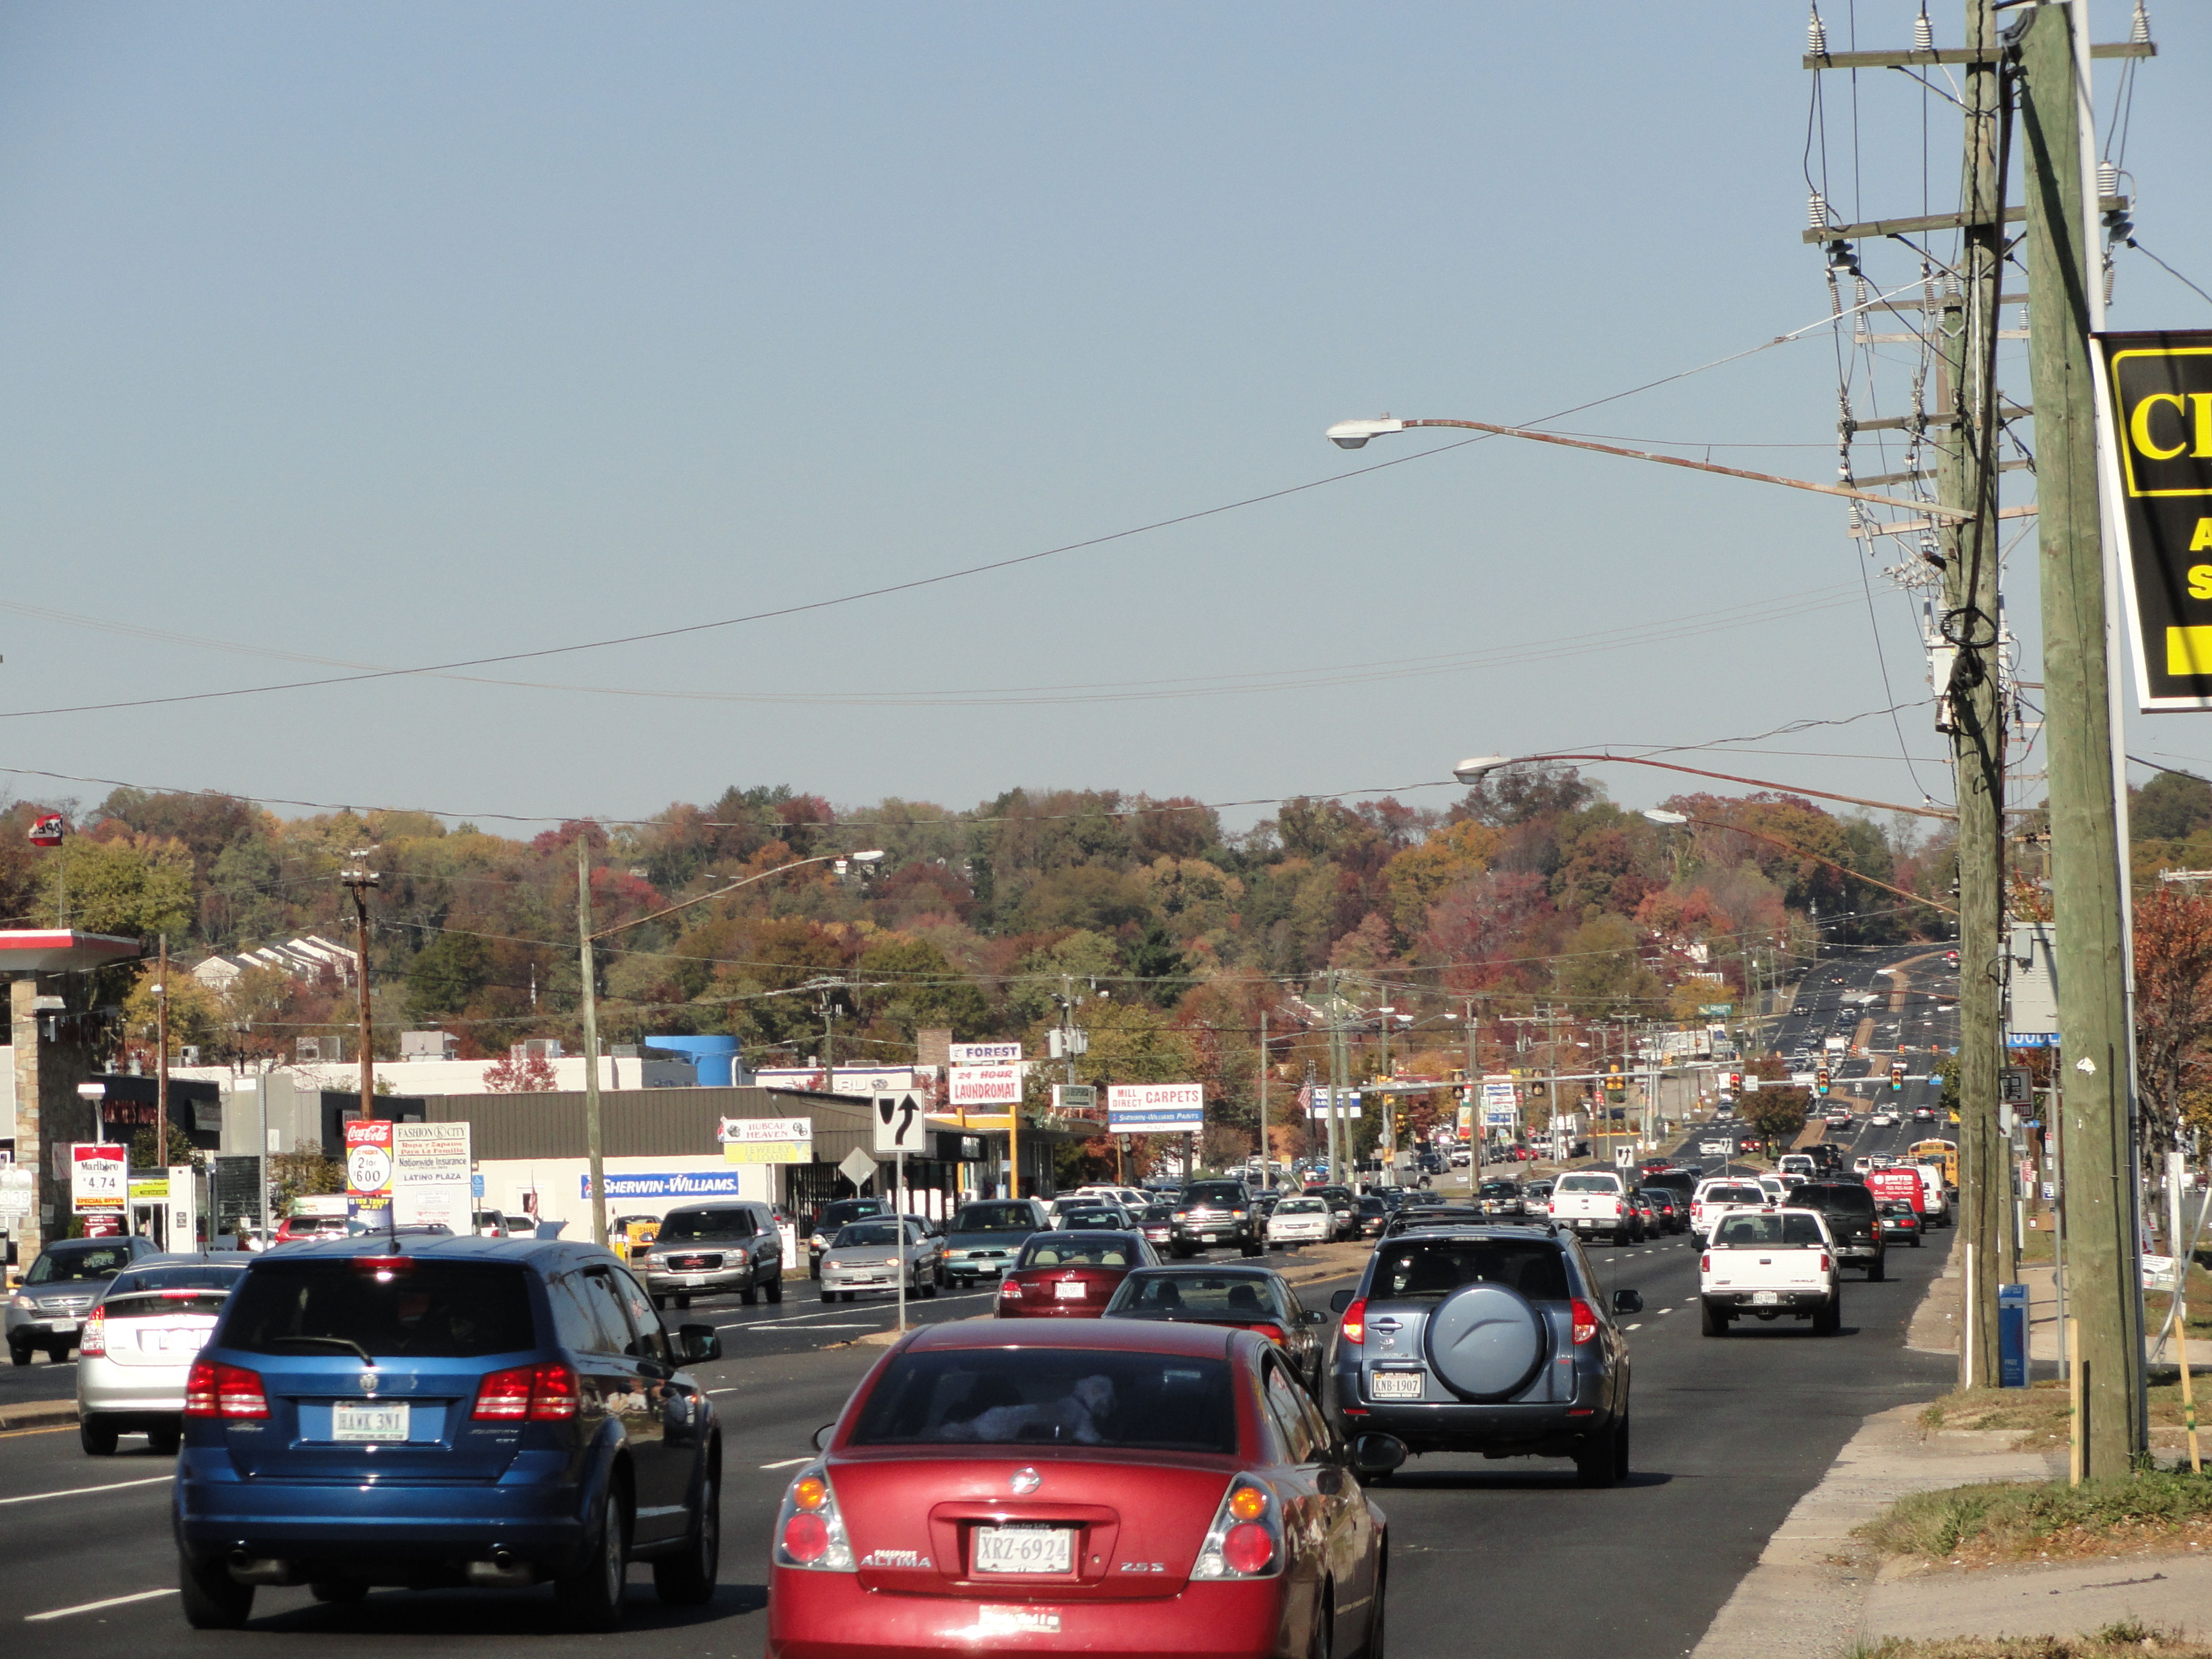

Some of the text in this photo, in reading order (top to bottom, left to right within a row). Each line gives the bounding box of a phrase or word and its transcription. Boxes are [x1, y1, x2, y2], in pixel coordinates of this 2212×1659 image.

[966, 1047, 1017, 1057] FOREST
[980, 1070, 1013, 1079] HOUR
[954, 1082, 1016, 1099] LAUNDROMAT
[1117, 1089, 1137, 1097] MILL
[1145, 1090, 1199, 1103] CARPETS
[1113, 1099, 1142, 1107] DIRECT
[748, 1122, 785, 1131] HUBCAP
[398, 1128, 433, 1137] FASHION
[446, 1127, 466, 1137] CITY
[746, 1131, 789, 1139] HEAVEN
[745, 1145, 792, 1156] JEWELRY
[399, 1157, 467, 1167] Nationwide Insurance
[757, 1153, 789, 1161] LOANS
[81, 1161, 119, 1172] Marlboro
[358, 1157, 365, 1169] 2
[603, 1175, 736, 1194] SHERWIN-WILLIAMS
[1375, 1380, 1418, 1391] KNB-1907
[981, 1537, 1067, 1561] XRZ-6924
[861, 1555, 931, 1567] ALTIMA
[1151, 1562, 1164, 1571] S
